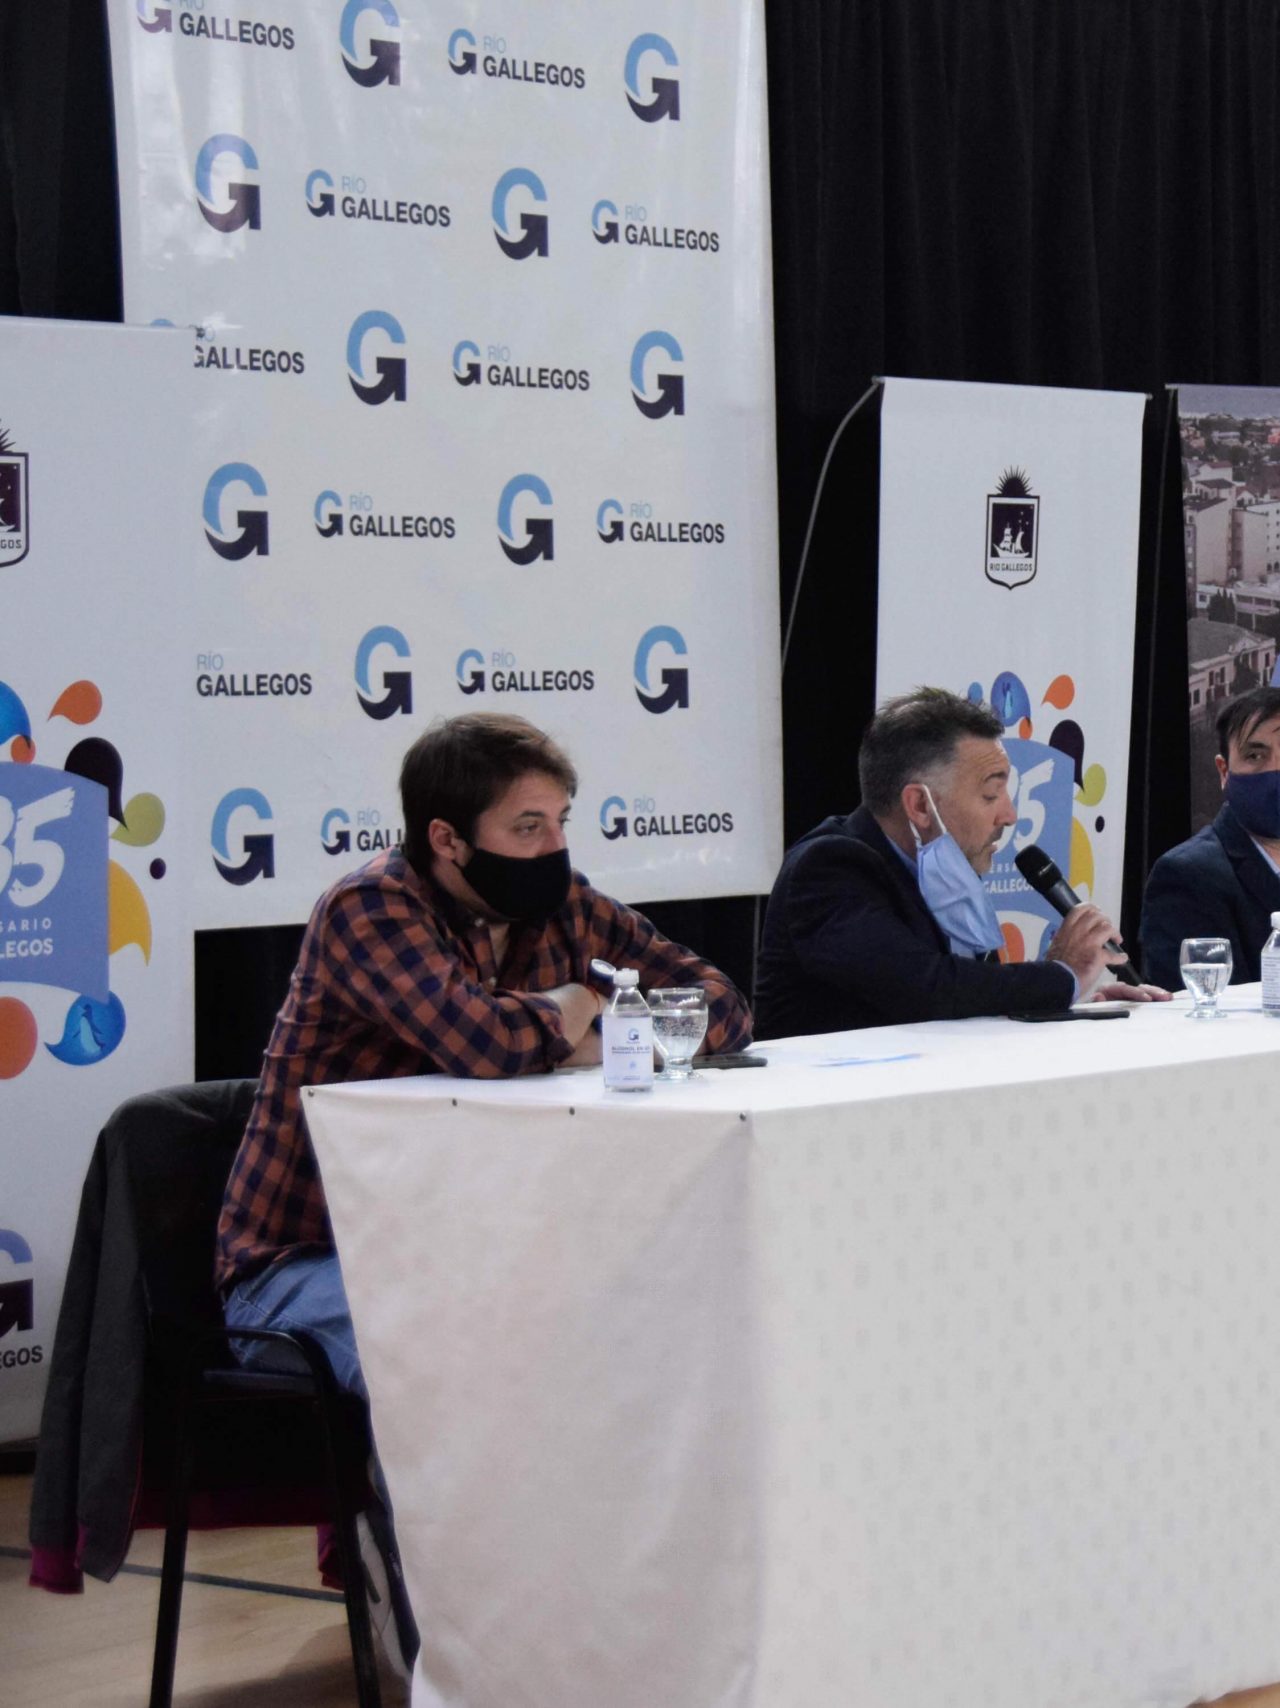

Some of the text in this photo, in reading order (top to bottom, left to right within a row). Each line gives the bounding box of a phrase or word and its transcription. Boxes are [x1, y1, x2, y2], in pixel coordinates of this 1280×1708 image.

[179, 12, 295, 50] GALLEGOS
[483, 56, 585, 89] GALLEGOS
[342, 196, 450, 227] GALLEGOS
[625, 224, 719, 252] GALLEGOS
[488, 365, 589, 391] GALLEGOS
[350, 515, 455, 538] GALLEGOS
[630, 522, 724, 543] GALLEGOS
[197, 673, 312, 697] GALLEGOS
[492, 670, 594, 692] GALLEGOS
[634, 813, 733, 837] GALLEGOS
[984, 877, 1034, 893] GALLEGO
[0, 938, 54, 958] EGOS
